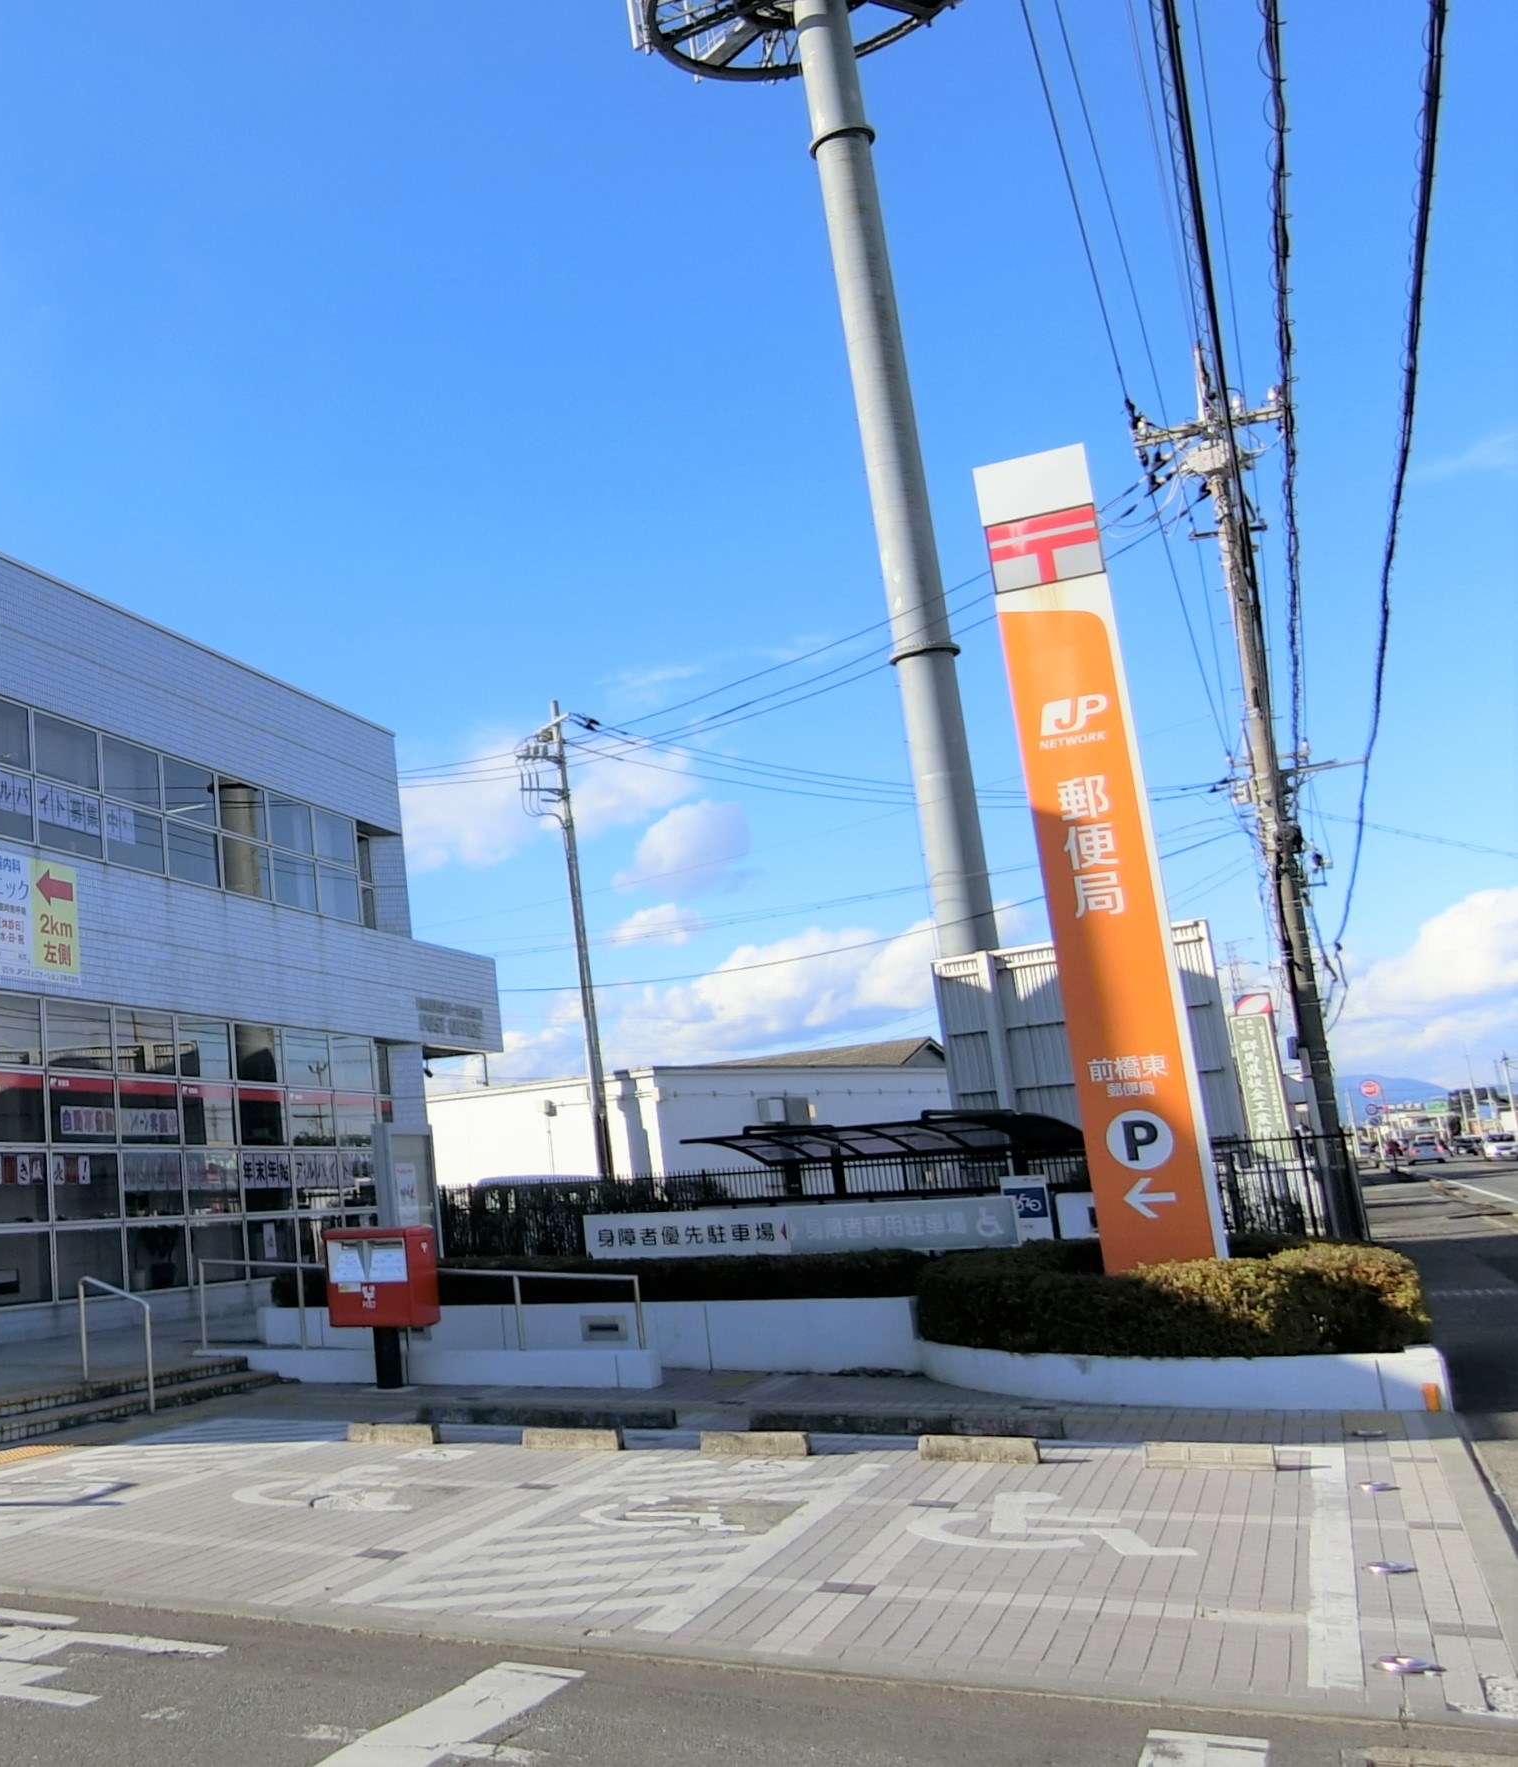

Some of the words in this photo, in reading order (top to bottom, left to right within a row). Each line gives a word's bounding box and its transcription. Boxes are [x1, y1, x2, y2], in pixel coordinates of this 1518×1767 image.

[1039, 731, 1106, 751] NETWORK
[1057, 774, 1125, 919] 郵便局
[39, 913, 73, 939] 2km
[43, 940, 72, 967] 左側
[1087, 1053, 1169, 1082] 前橋東
[1106, 1081, 1156, 1098] 郵便局
[1121, 1119, 1159, 1162] P
[597, 1222, 775, 1248] 身障者優先駐車場
[805, 1210, 967, 1241] 身障者専用駐車場
